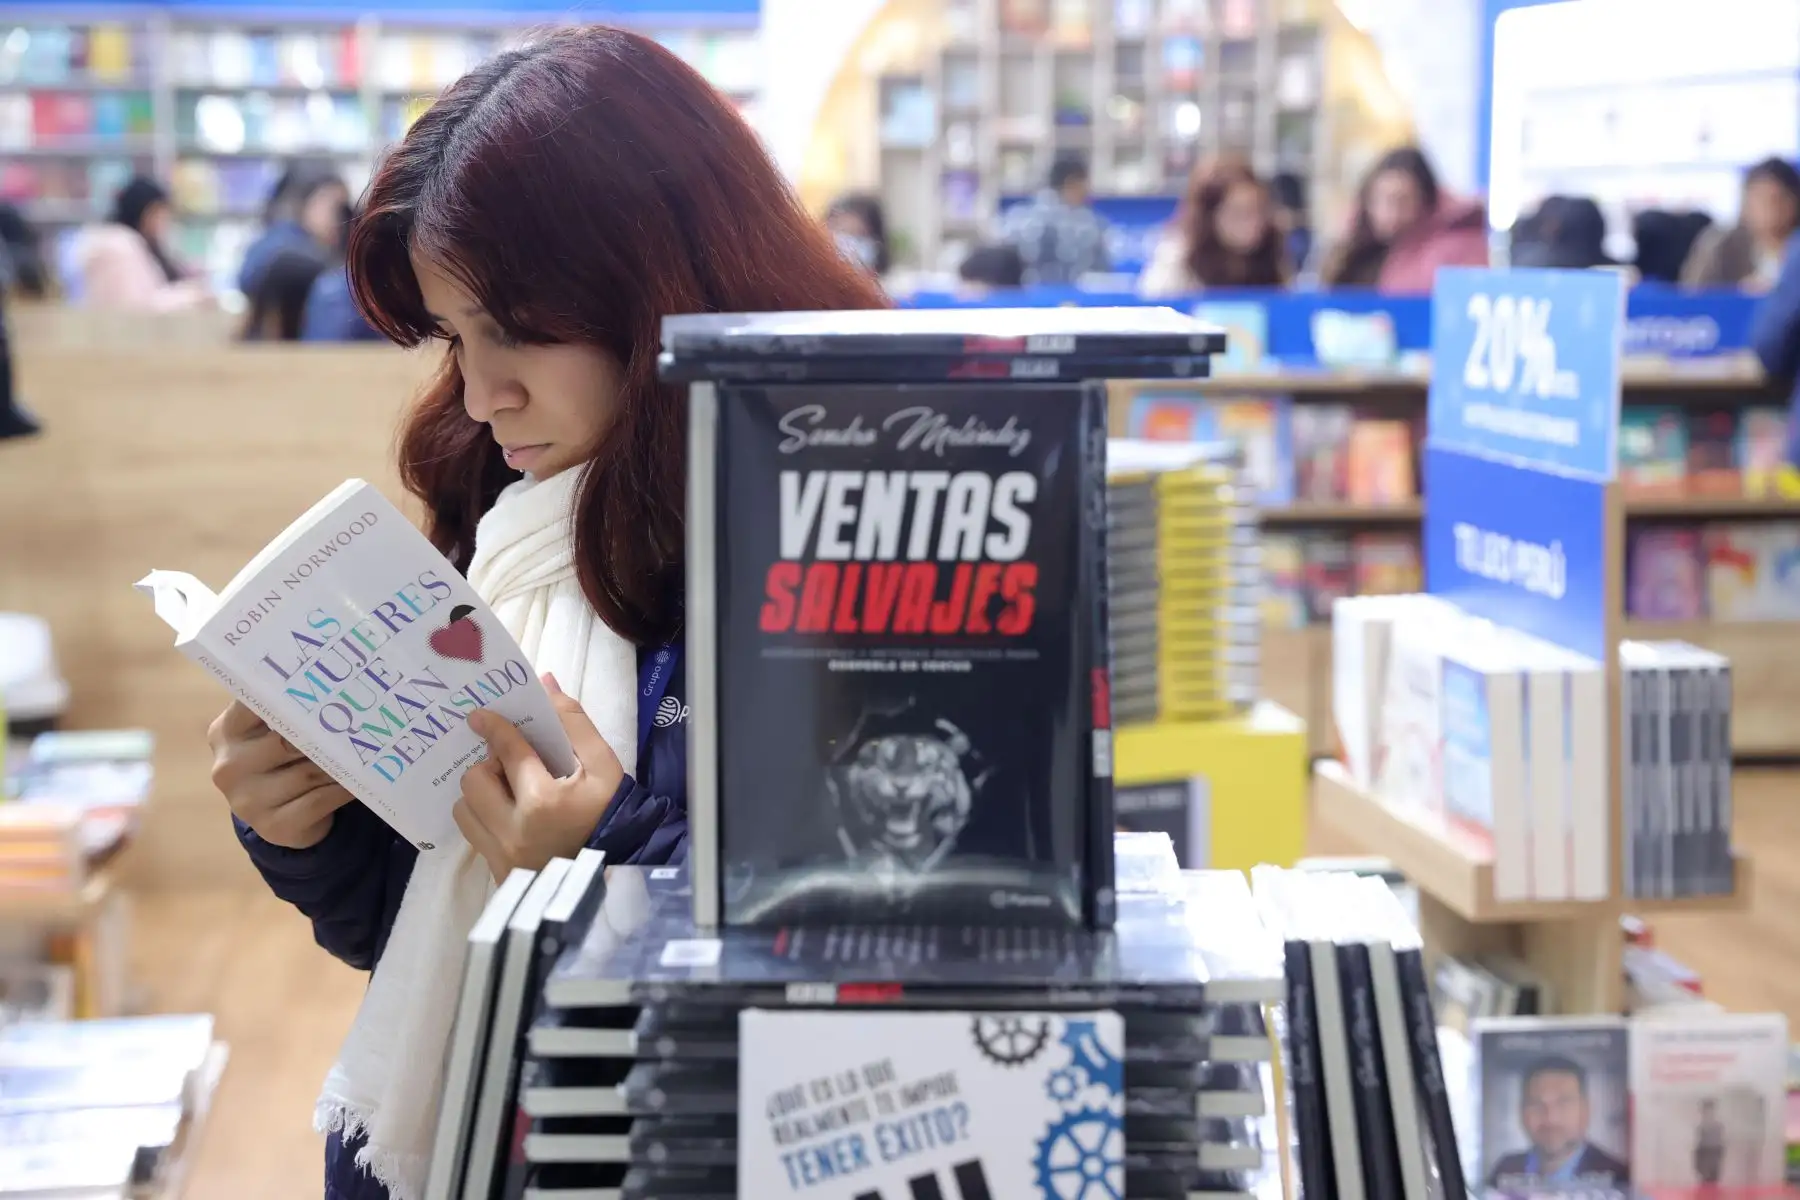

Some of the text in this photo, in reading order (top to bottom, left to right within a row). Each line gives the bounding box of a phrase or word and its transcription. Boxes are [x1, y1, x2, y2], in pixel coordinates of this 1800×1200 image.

[1464, 293, 1556, 399] 20%
[779, 470, 1038, 561] VENTAS
[224, 511, 378, 646] ROBIN NORWOOD
[759, 561, 1039, 635] SALVAJES
[261, 608, 341, 681] LAS
[286, 570, 451, 713] MUJERES
[644, 665, 662, 696] Grupo
[319, 657, 403, 734] QUE
[349, 665, 449, 765] AMAN
[372, 659, 528, 783] DEMASIADO
[432, 778, 441, 787] El
[440, 768, 454, 782] gran
[453, 753, 471, 769] clásico
[470, 743, 485, 755] que
[780, 1133, 872, 1191] TENER
